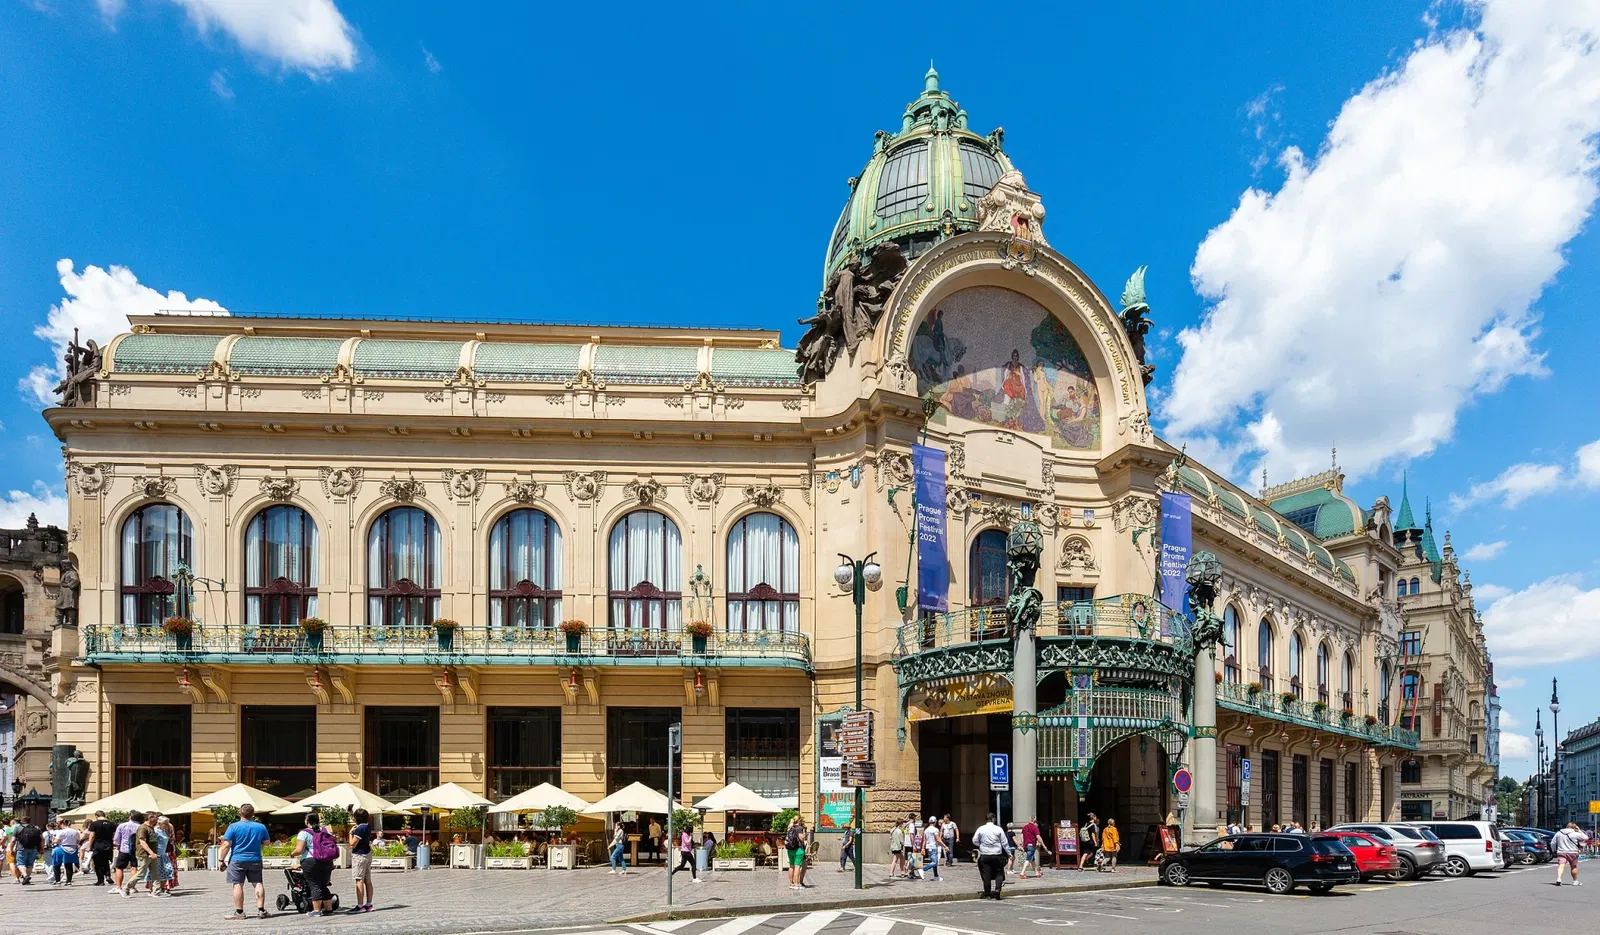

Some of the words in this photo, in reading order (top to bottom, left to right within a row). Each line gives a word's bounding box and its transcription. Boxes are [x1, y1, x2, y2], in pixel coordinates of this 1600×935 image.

[918, 503, 942, 516] Prague
[919, 513, 941, 525] Proms
[919, 523, 944, 535] Festival
[919, 533, 937, 543] 2022
[1163, 543, 1187, 553] Prague
[1163, 552, 1185, 561] Proms
[1163, 569, 1181, 577] 2022
[986, 689, 1010, 700] ZNOVU
[994, 757, 1004, 774] P
